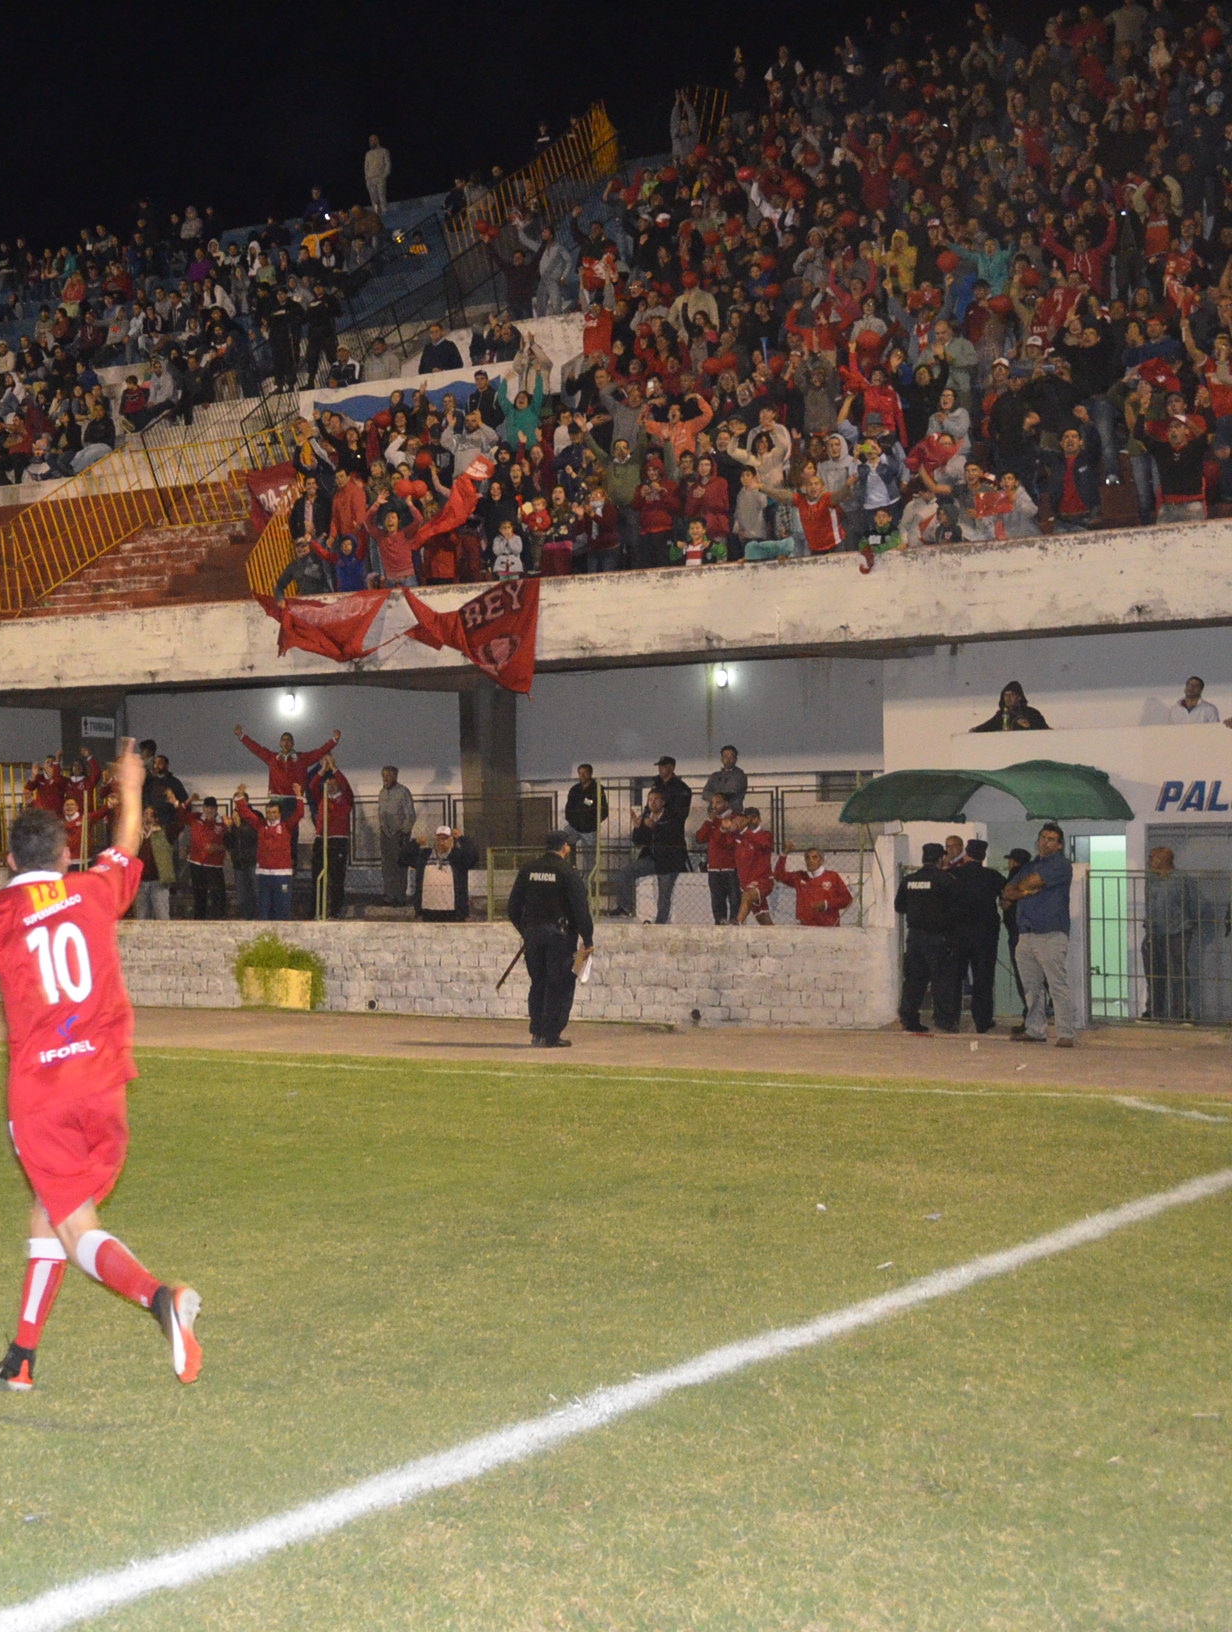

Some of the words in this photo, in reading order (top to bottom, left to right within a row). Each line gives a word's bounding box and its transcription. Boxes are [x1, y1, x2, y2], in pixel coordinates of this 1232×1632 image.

[465, 579, 523, 628] REY
[1155, 780, 1232, 812] PAL
[34, 882, 59, 903] 18
[529, 871, 556, 882] POLICIA
[23, 894, 82, 926] SUPERMERCADO
[26, 921, 93, 1005] 10
